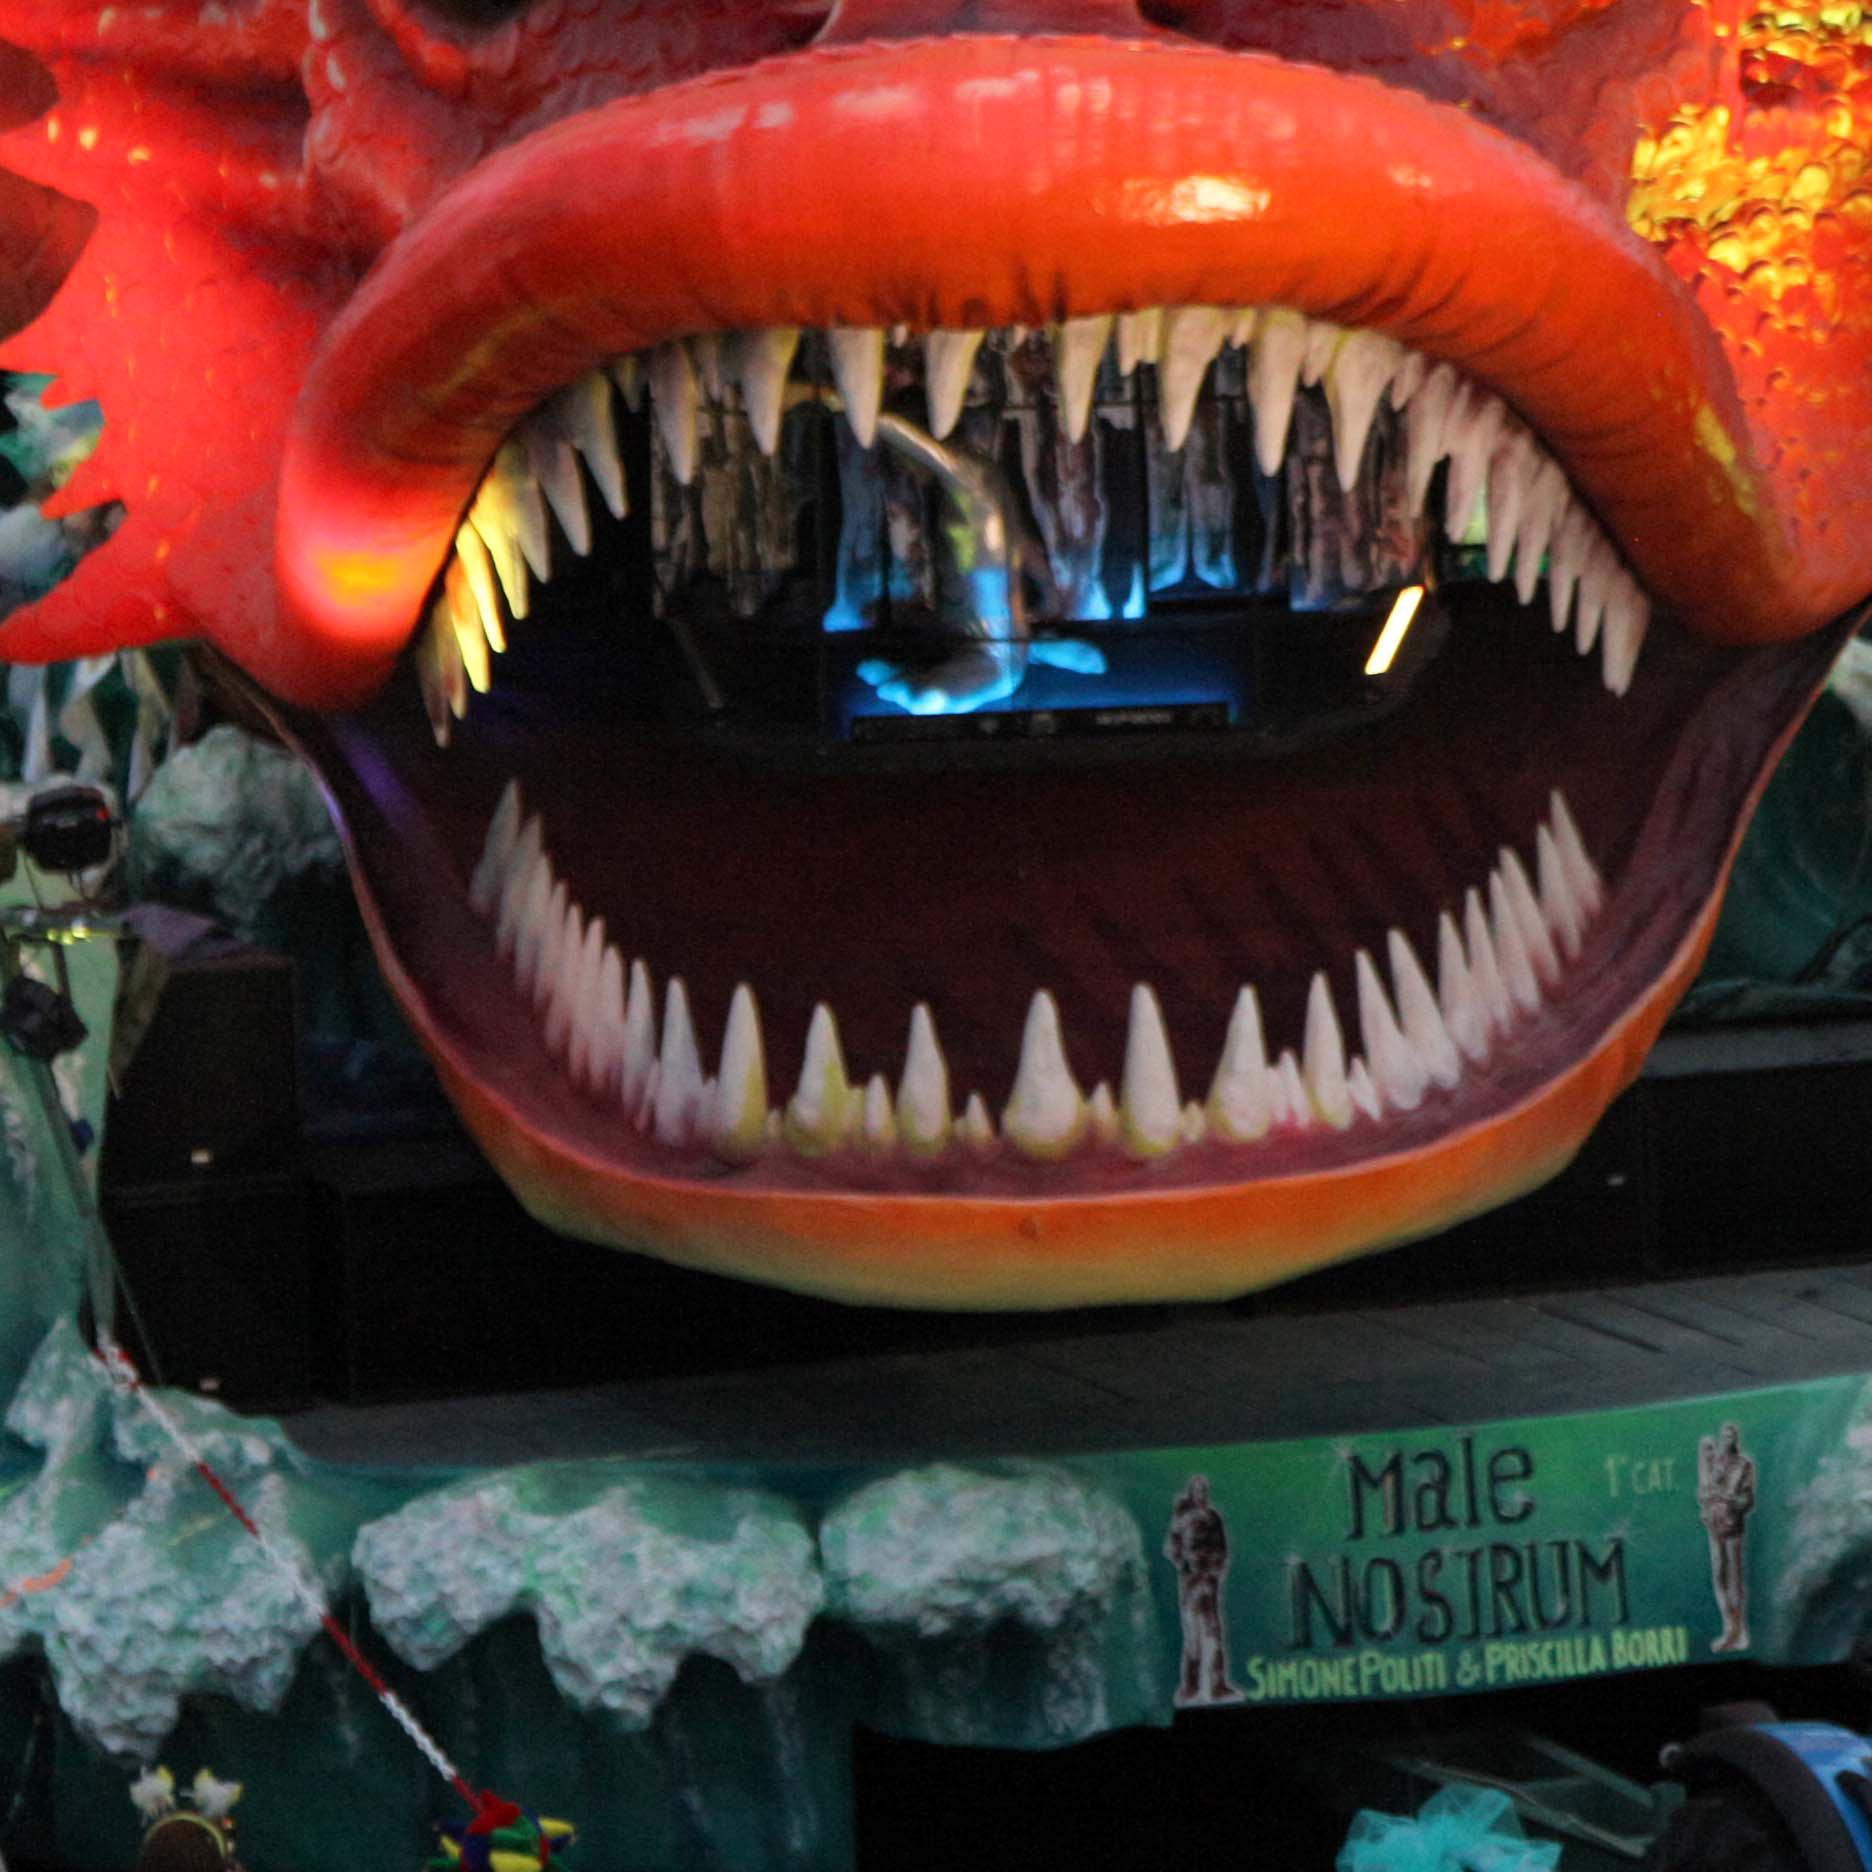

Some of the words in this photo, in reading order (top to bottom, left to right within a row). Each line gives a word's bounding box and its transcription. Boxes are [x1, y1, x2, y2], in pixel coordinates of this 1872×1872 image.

[1347, 1433, 1536, 1540] Male
[1288, 1538, 1629, 1649] NOSTRUM
[1456, 1651, 1482, 1687] &
[1485, 1636, 1606, 1685] PRISCILLA
[1613, 1627, 1690, 1669] BORRI
